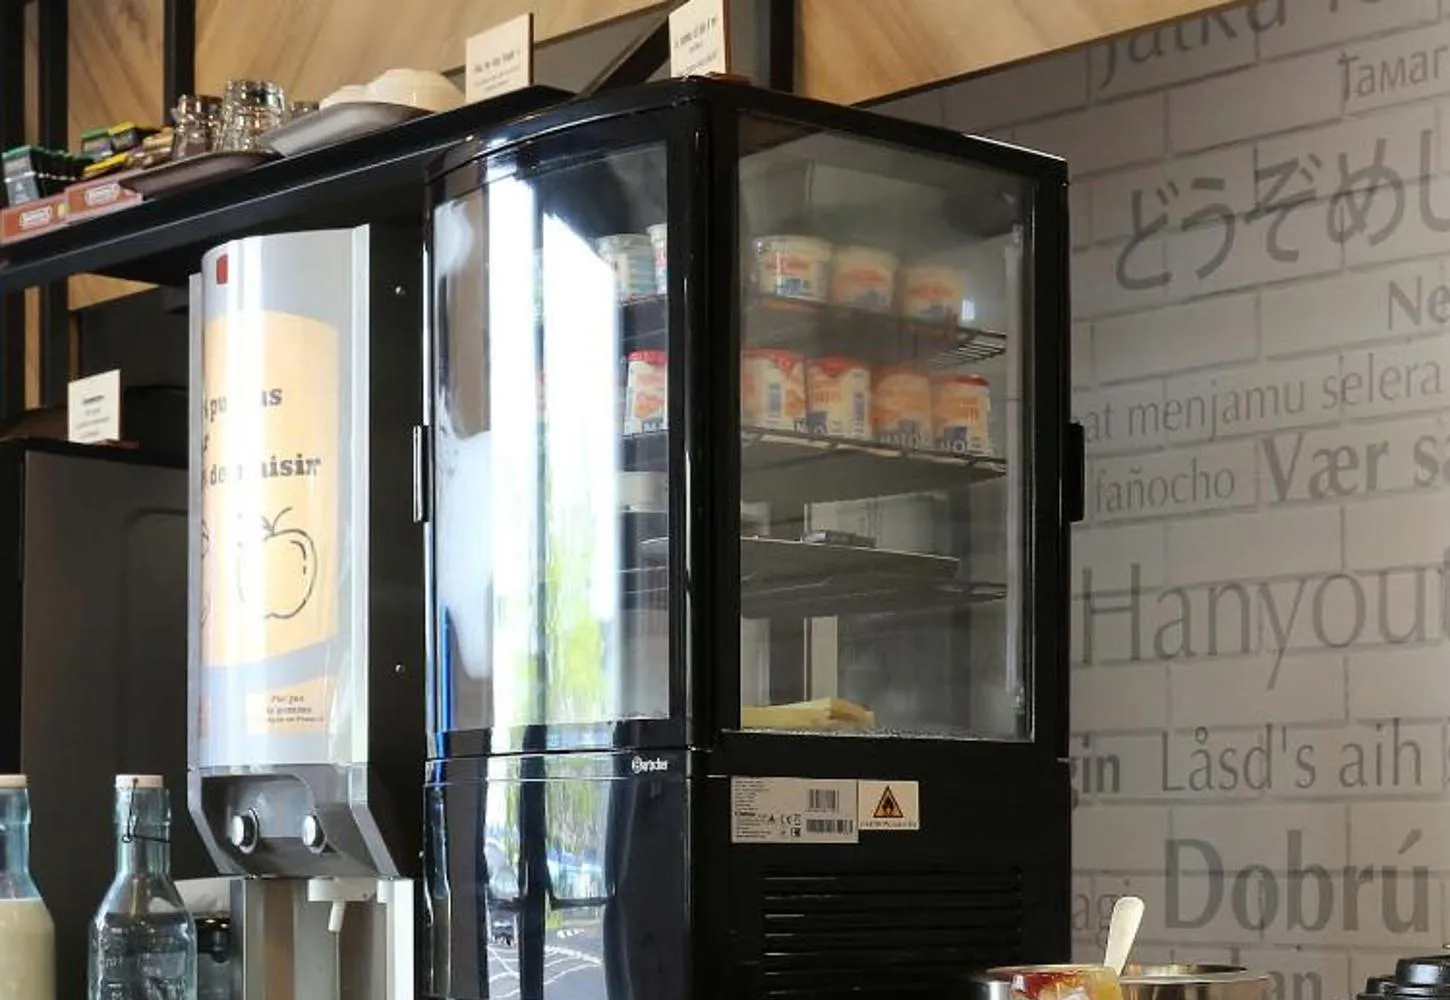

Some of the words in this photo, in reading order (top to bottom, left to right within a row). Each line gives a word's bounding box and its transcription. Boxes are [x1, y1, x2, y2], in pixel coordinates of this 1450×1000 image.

[1128, 378, 1302, 443] menjamu
[1322, 353, 1442, 409] selera
[1261, 431, 1390, 502] Vær
[1161, 724, 1316, 792] Låsd's
[1339, 716, 1423, 788] aih
[1163, 827, 1430, 935] Dobrú
